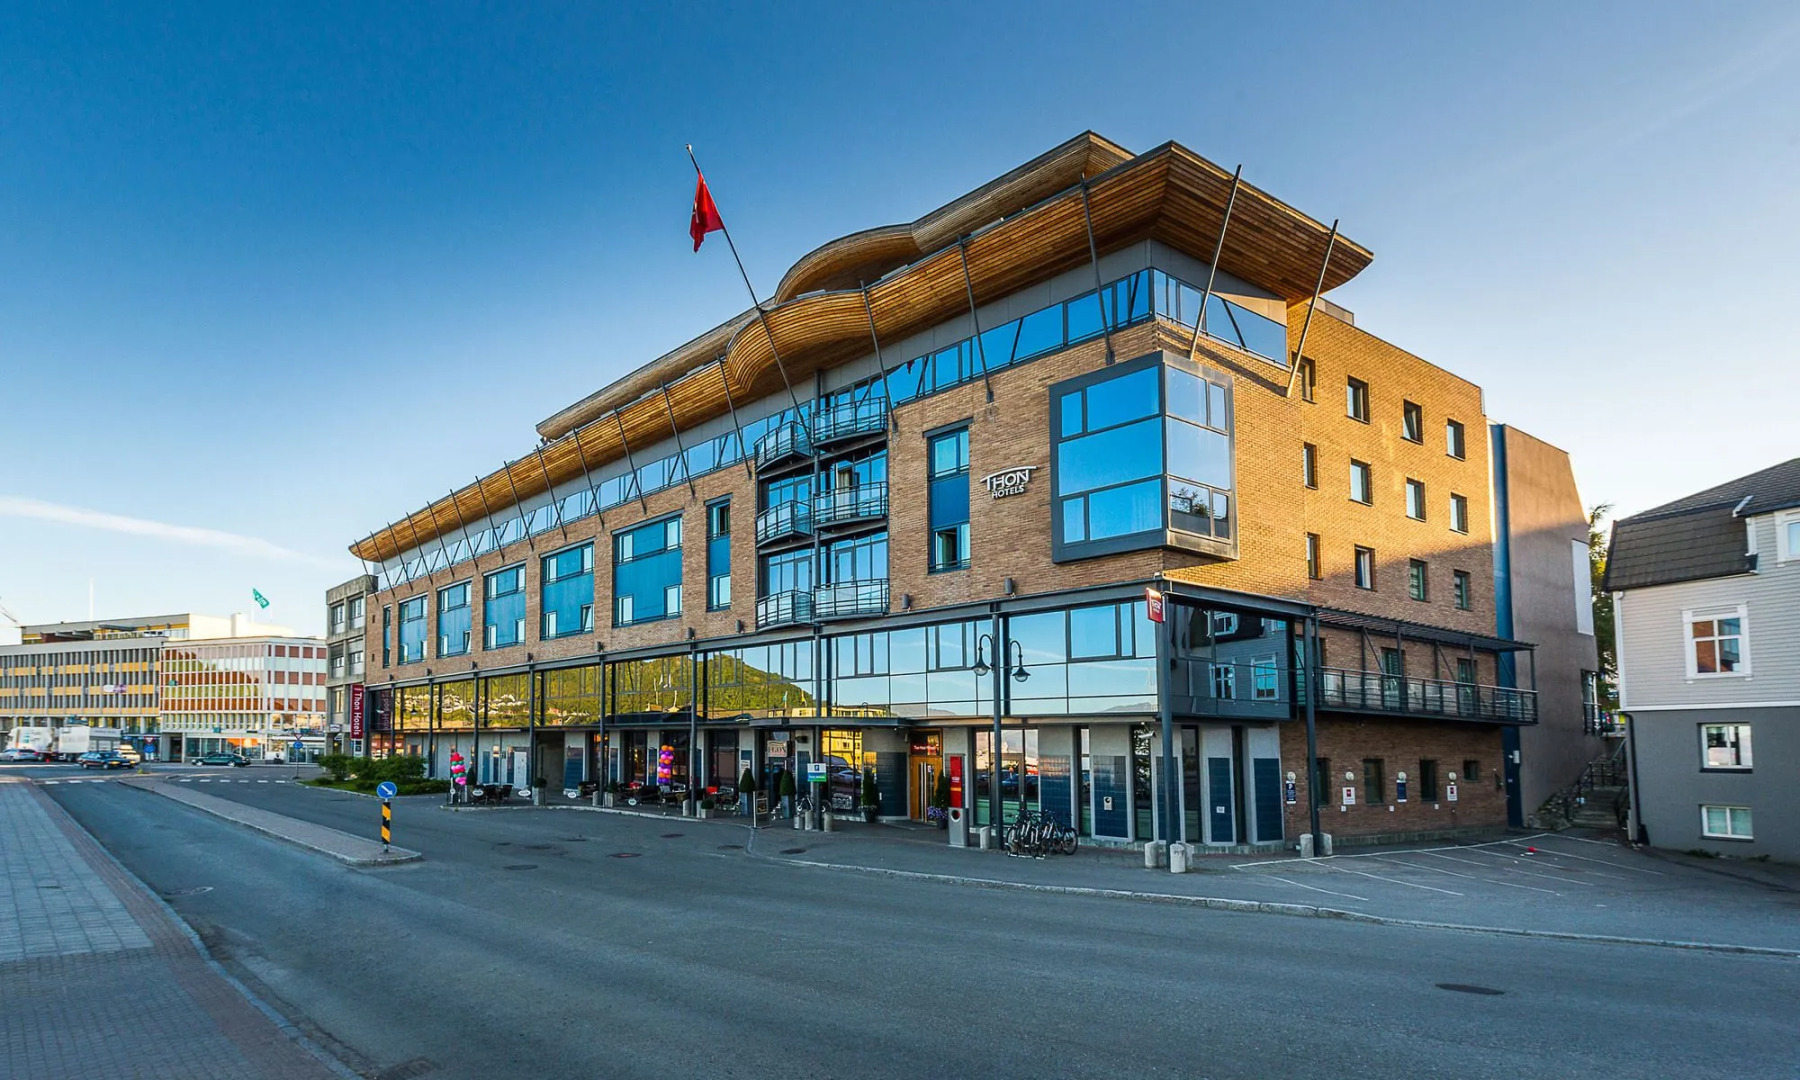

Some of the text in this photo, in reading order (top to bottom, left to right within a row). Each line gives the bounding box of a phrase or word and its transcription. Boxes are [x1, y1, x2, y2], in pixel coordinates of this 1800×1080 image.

[980, 466, 1037, 491] THON
[992, 485, 1025, 499] HOTELS
[353, 693, 363, 735] Thon Hotels
